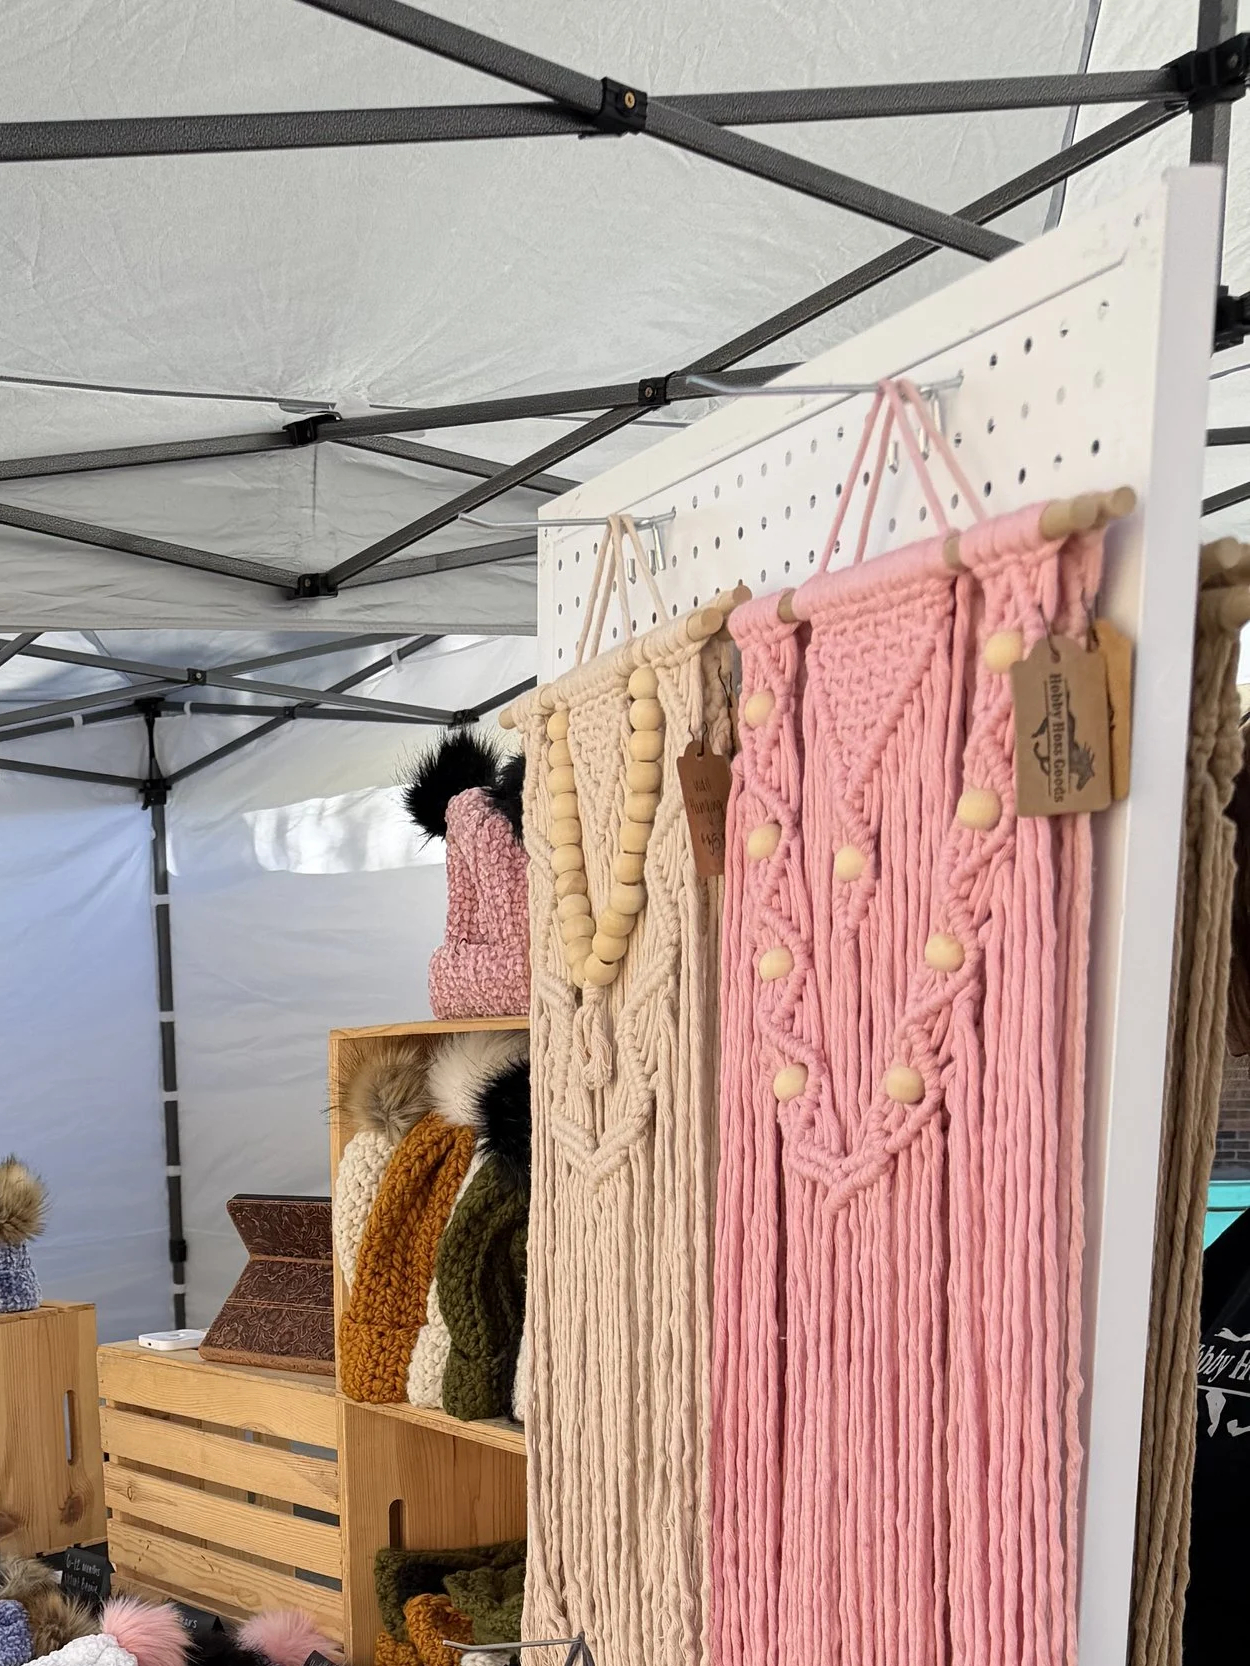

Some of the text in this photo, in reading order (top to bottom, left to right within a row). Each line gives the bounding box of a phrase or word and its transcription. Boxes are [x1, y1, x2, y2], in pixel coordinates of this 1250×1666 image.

[1049, 673, 1066, 803] Hobby Hoss Goods
[1197, 1343, 1236, 1383] bby
